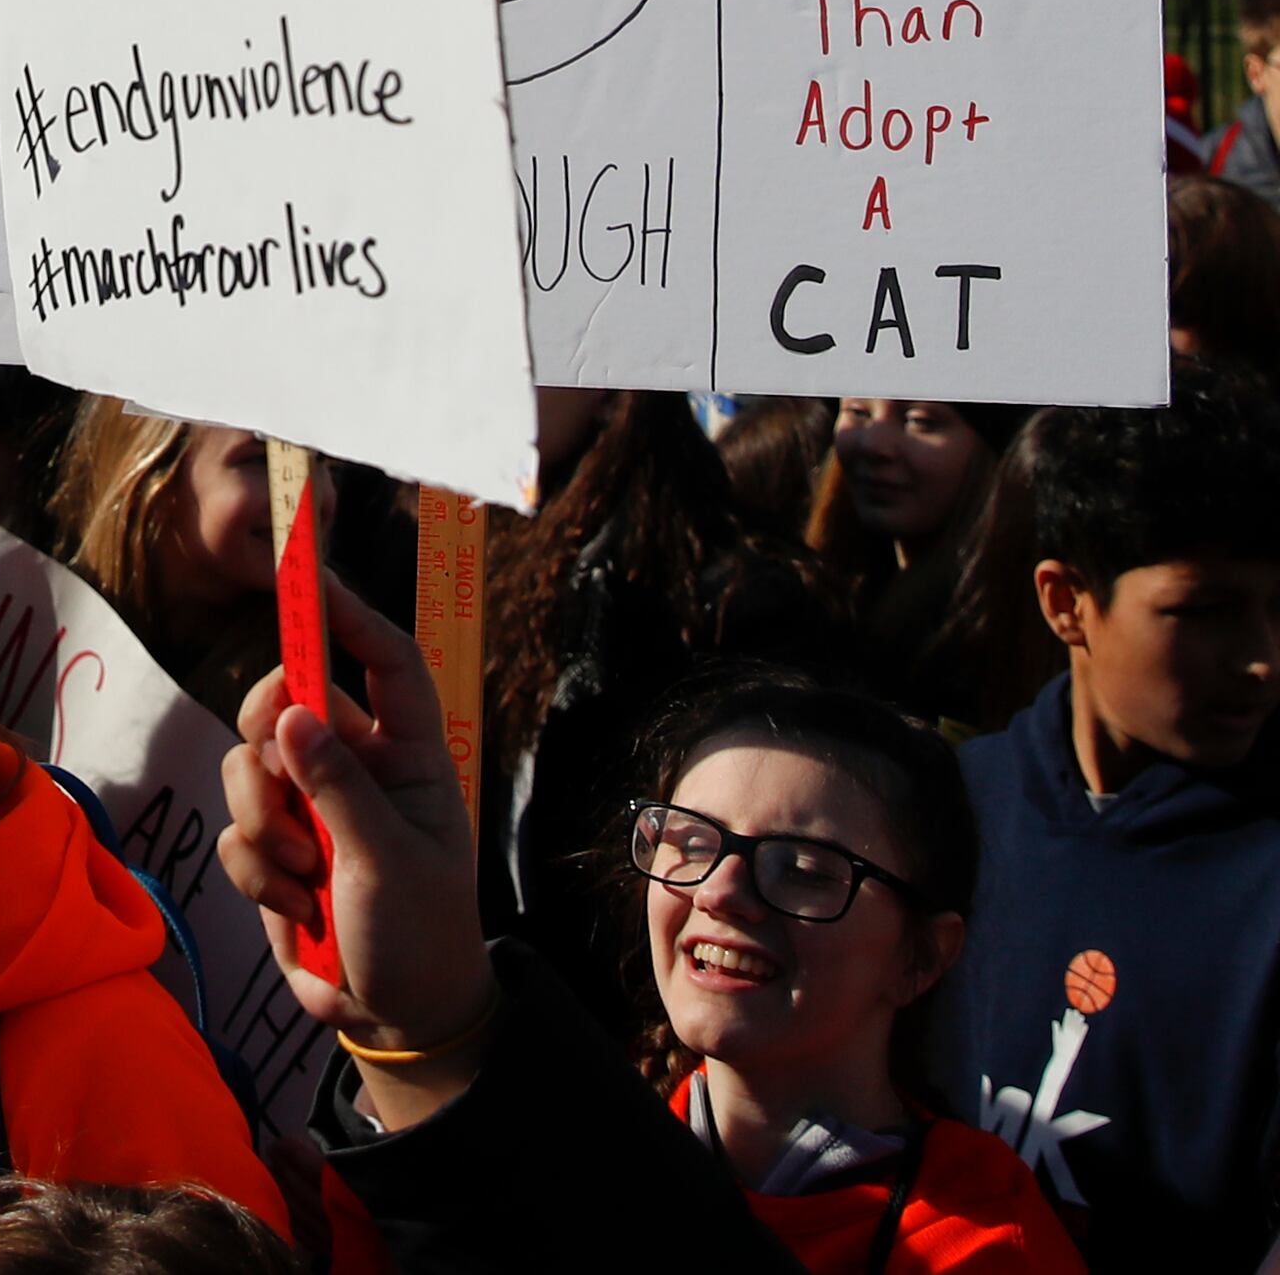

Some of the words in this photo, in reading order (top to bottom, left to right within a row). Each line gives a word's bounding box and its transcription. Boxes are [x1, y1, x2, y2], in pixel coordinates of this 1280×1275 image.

[15, 16, 414, 201] #endgunviolence
[795, 79, 991, 164] Adopt
[862, 176, 892, 230] A
[770, 263, 1002, 358] CAT
[435, 500, 447, 521] 19
[433, 550, 446, 571] 18
[454, 543, 476, 620] HOME
[432, 599, 444, 620] 17
[431, 648, 443, 669] 16
